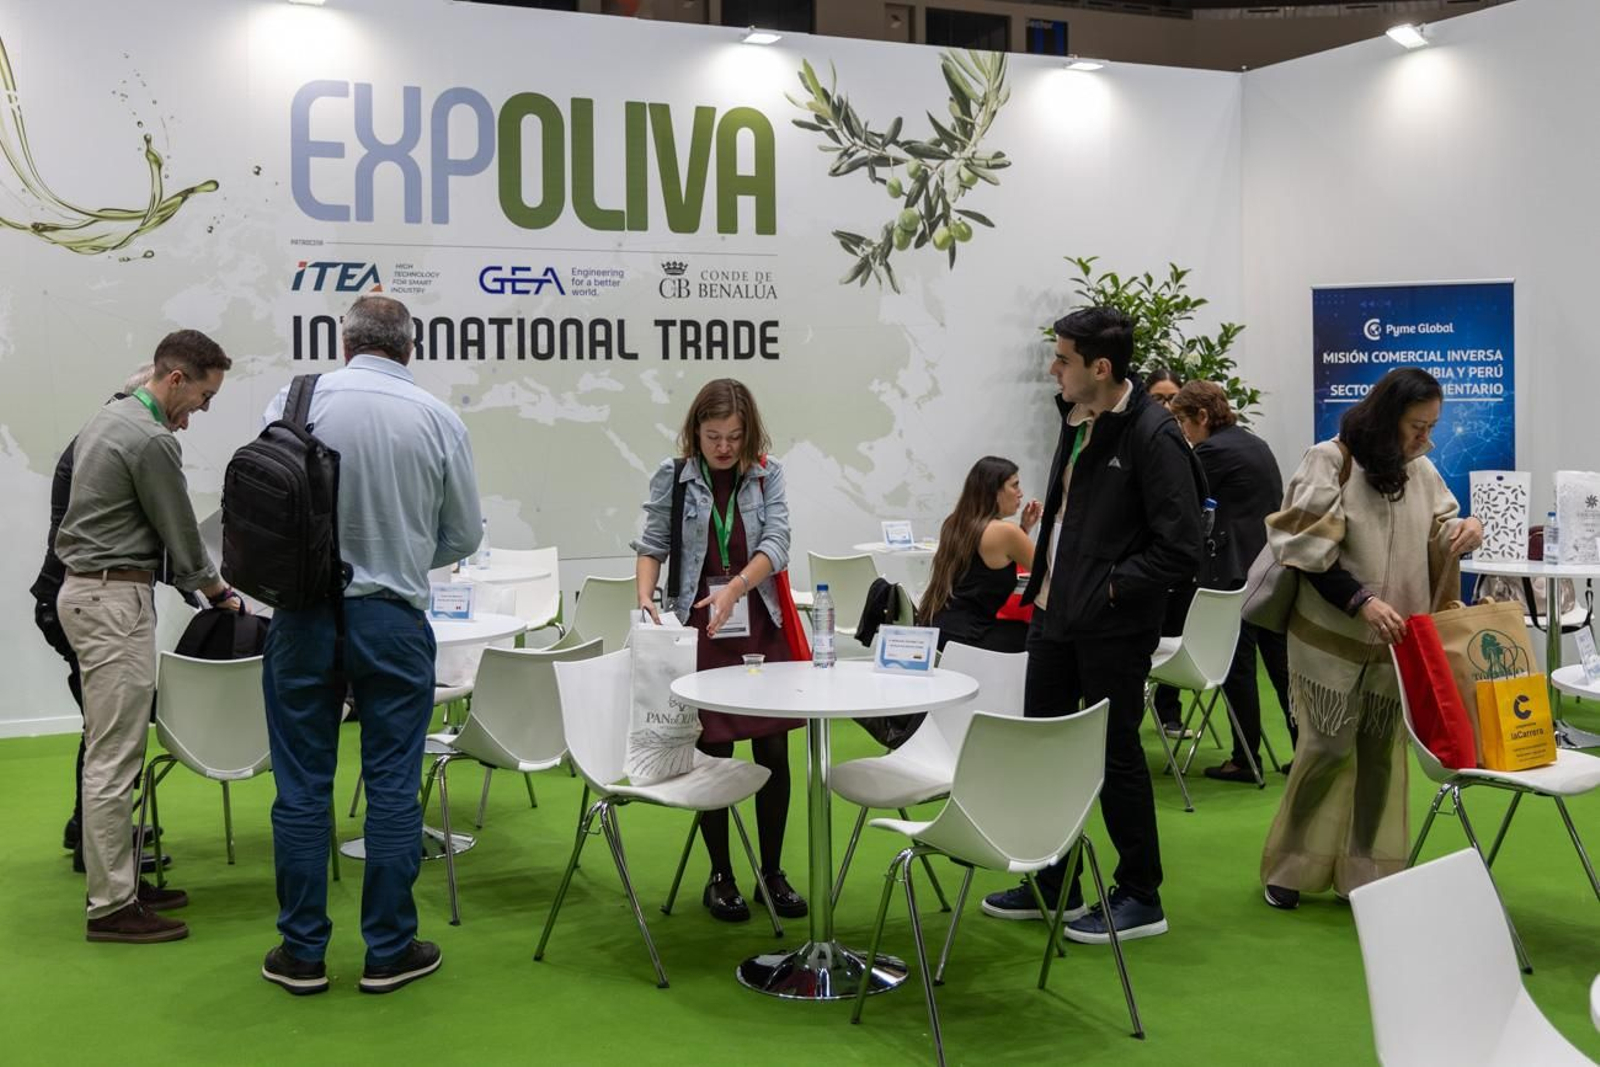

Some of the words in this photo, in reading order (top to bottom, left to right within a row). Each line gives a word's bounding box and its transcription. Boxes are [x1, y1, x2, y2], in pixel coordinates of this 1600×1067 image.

[290, 79, 777, 235] EXPOLIVA
[571, 267, 625, 279] Engineering
[700, 269, 749, 281] CONDE
[755, 271, 772, 282] DE
[479, 265, 566, 296] GEA
[571, 278, 584, 287] for
[594, 279, 621, 287] better
[571, 287, 600, 297] world.
[698, 281, 778, 300] BENALÚA
[1386, 324, 1416, 337] Pyme
[1418, 323, 1454, 334] Global
[654, 319, 780, 360] TRADE
[1323, 349, 1368, 364] MISIÓN
[1371, 350, 1444, 363] COMERCIAL
[1447, 349, 1504, 362] INVERSA
[1457, 367, 1466, 379] Y
[1469, 364, 1504, 379] PERÚ
[1511, 727, 1544, 741] laCarrera
